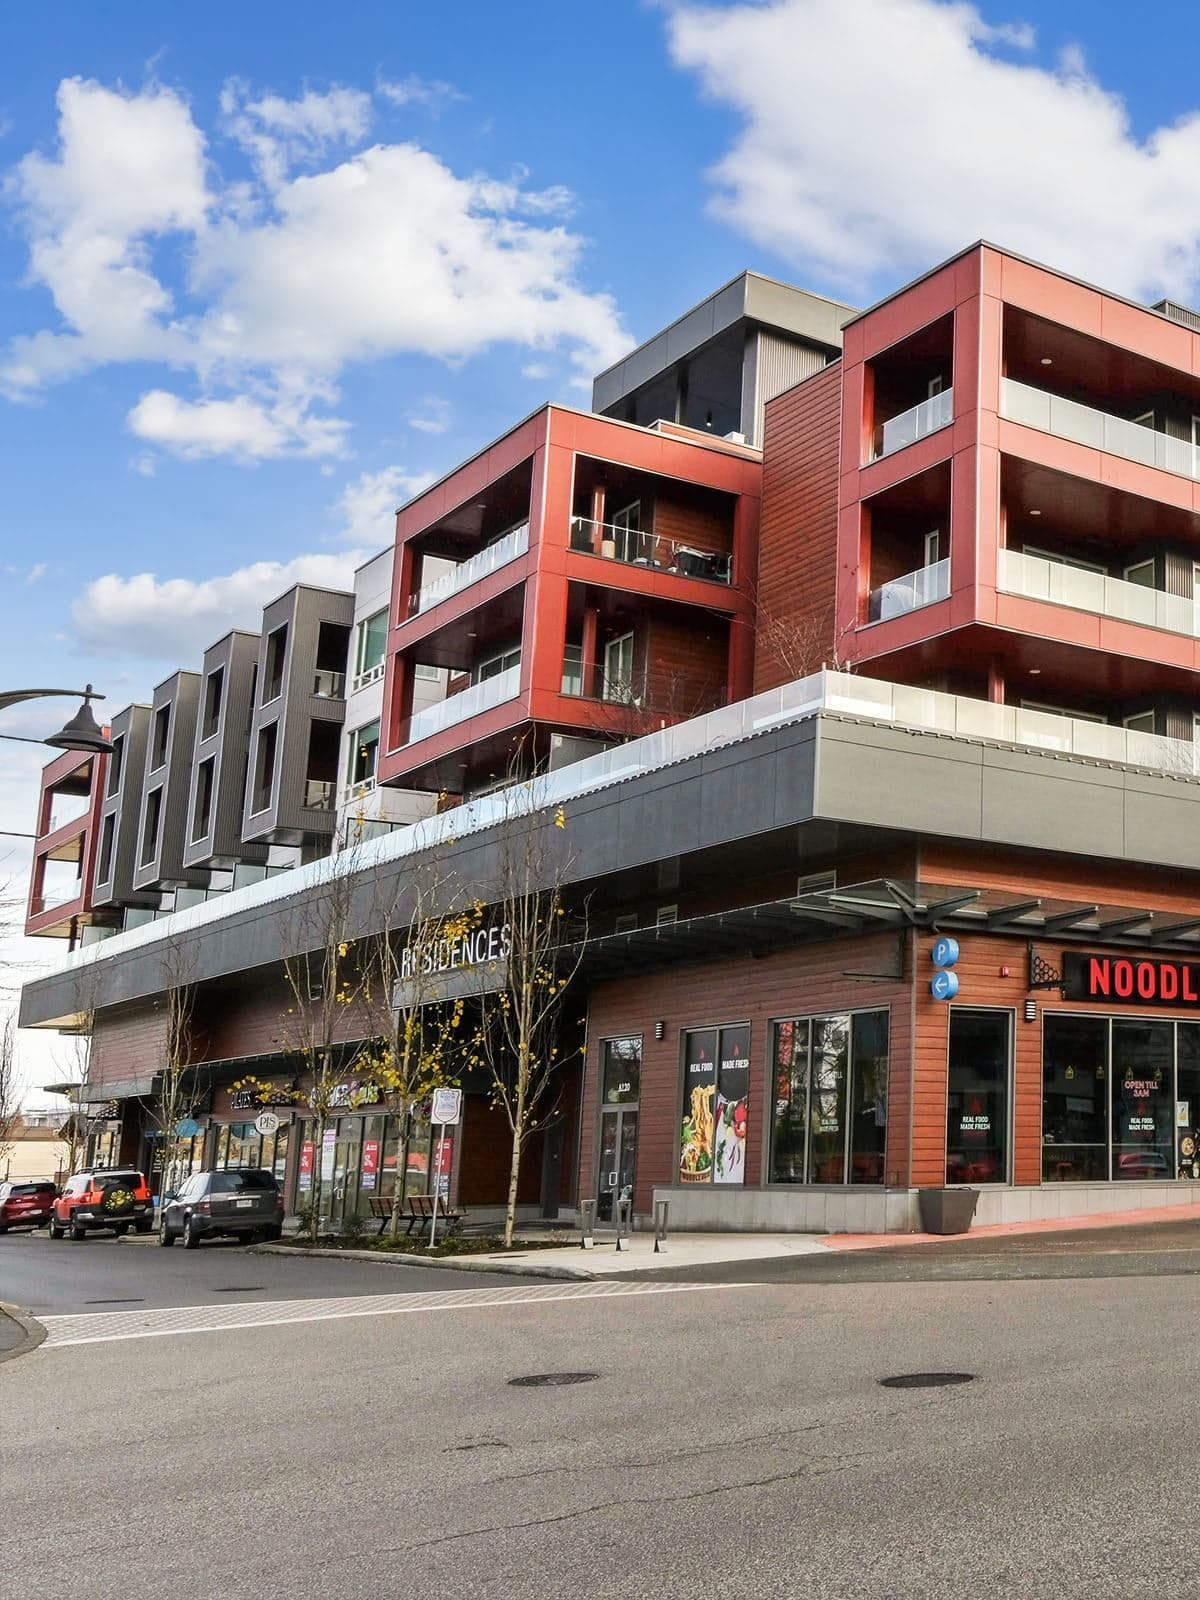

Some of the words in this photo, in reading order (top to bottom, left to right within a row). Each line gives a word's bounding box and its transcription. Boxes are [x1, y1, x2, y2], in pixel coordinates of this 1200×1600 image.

[701, 1062, 713, 1072] FOOD
[722, 1060, 734, 1070] MADE
[1125, 1081, 1144, 1089] OPEN
[1145, 1081, 1158, 1090] TILL
